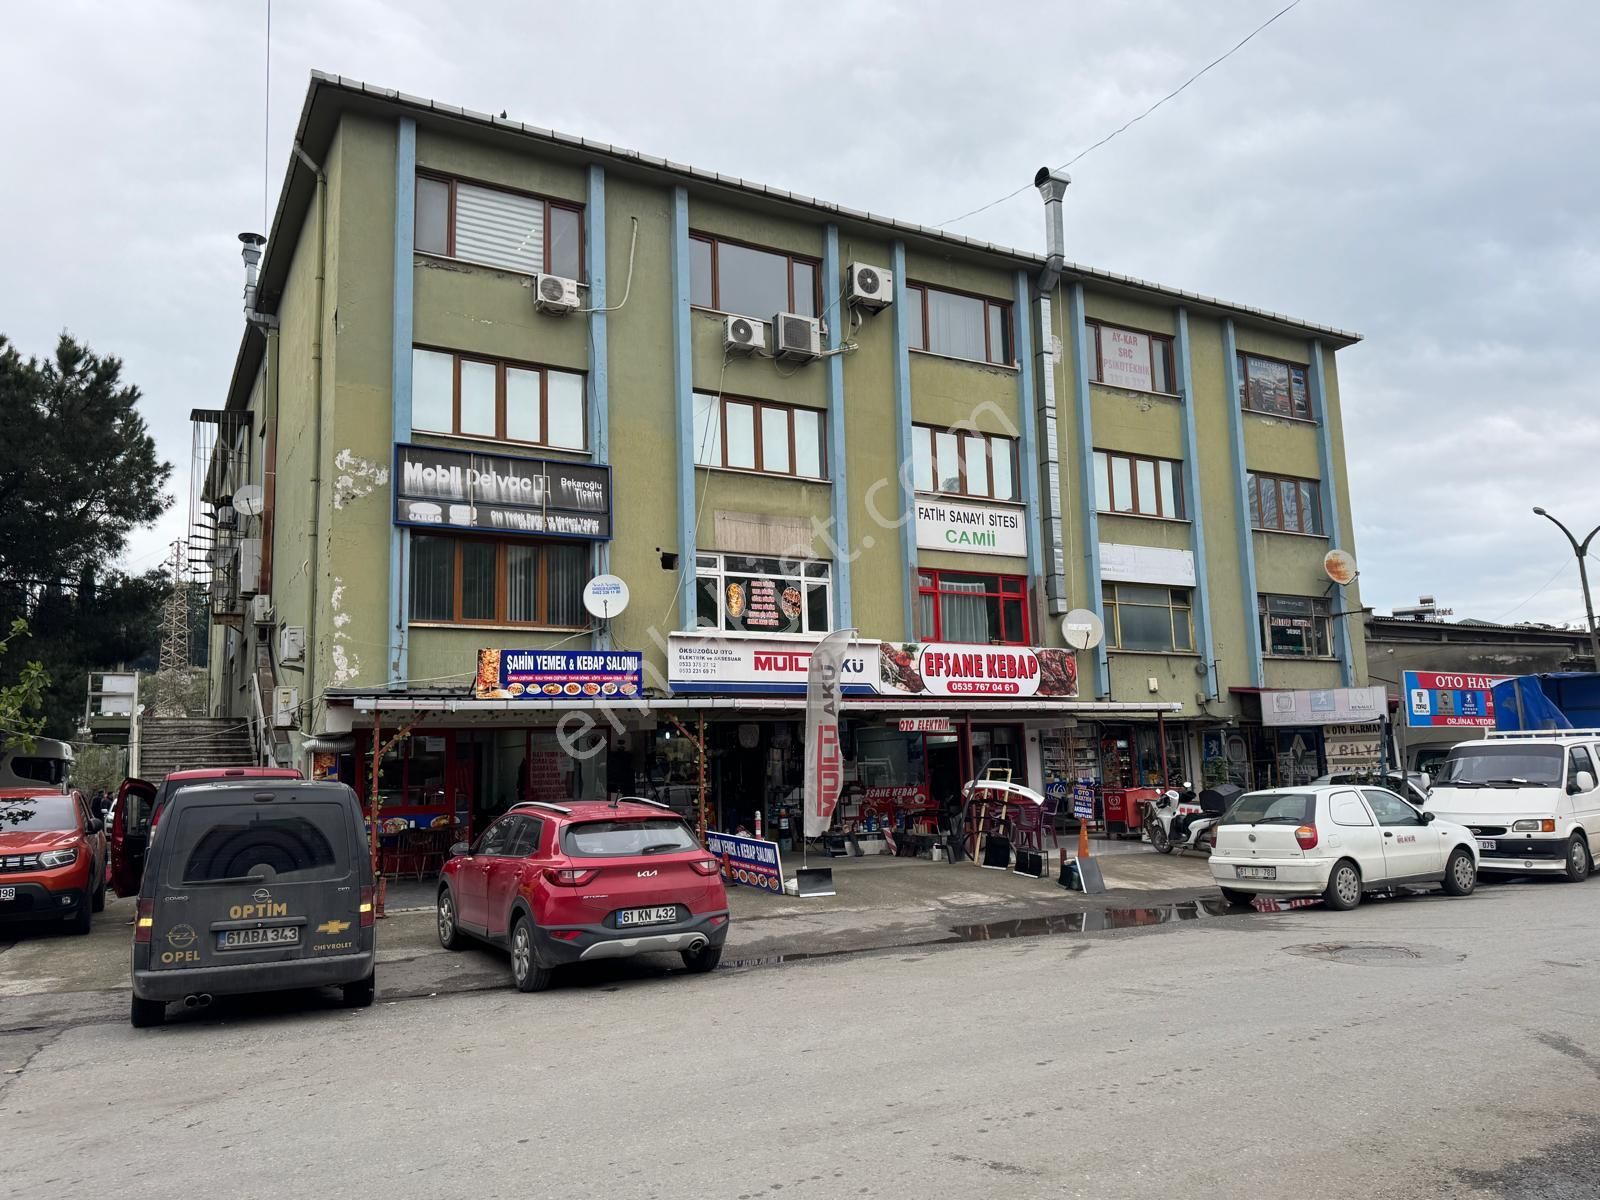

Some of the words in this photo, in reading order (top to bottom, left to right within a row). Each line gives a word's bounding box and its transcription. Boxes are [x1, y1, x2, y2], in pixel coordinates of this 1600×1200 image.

[467, 468, 532, 491] Delvac
[918, 506, 945, 522] FATİH
[949, 509, 985, 527] SANAYİ
[989, 512, 1018, 529] SİTESİ
[507, 651, 534, 674] ŞAHİN
[536, 654, 567, 671] YEMEK
[569, 661, 575, 670] &
[576, 655, 604, 671] KEBAP
[606, 655, 638, 672] SALONU
[925, 652, 984, 679] EFSANE
[986, 653, 1038, 680] KEBAP
[952, 683, 973, 691] 0535
[975, 683, 990, 691] 767
[1004, 684, 1014, 692] 61
[1436, 675, 1463, 689] OTO
[900, 719, 914, 731] OTO
[1447, 716, 1473, 725] ORJİNAL
[1332, 726, 1347, 735] OTO
[721, 840, 737, 855] YEMEK
[740, 843, 755, 860] KEBAP
[757, 846, 775, 864] SALONU
[229, 900, 287, 919] OPTİM
[623, 911, 634, 922] 61
[638, 909, 651, 921] KN
[655, 908, 675, 920] 432
[313, 942, 352, 950] CHEVROLET
[161, 950, 200, 963] OPEL
